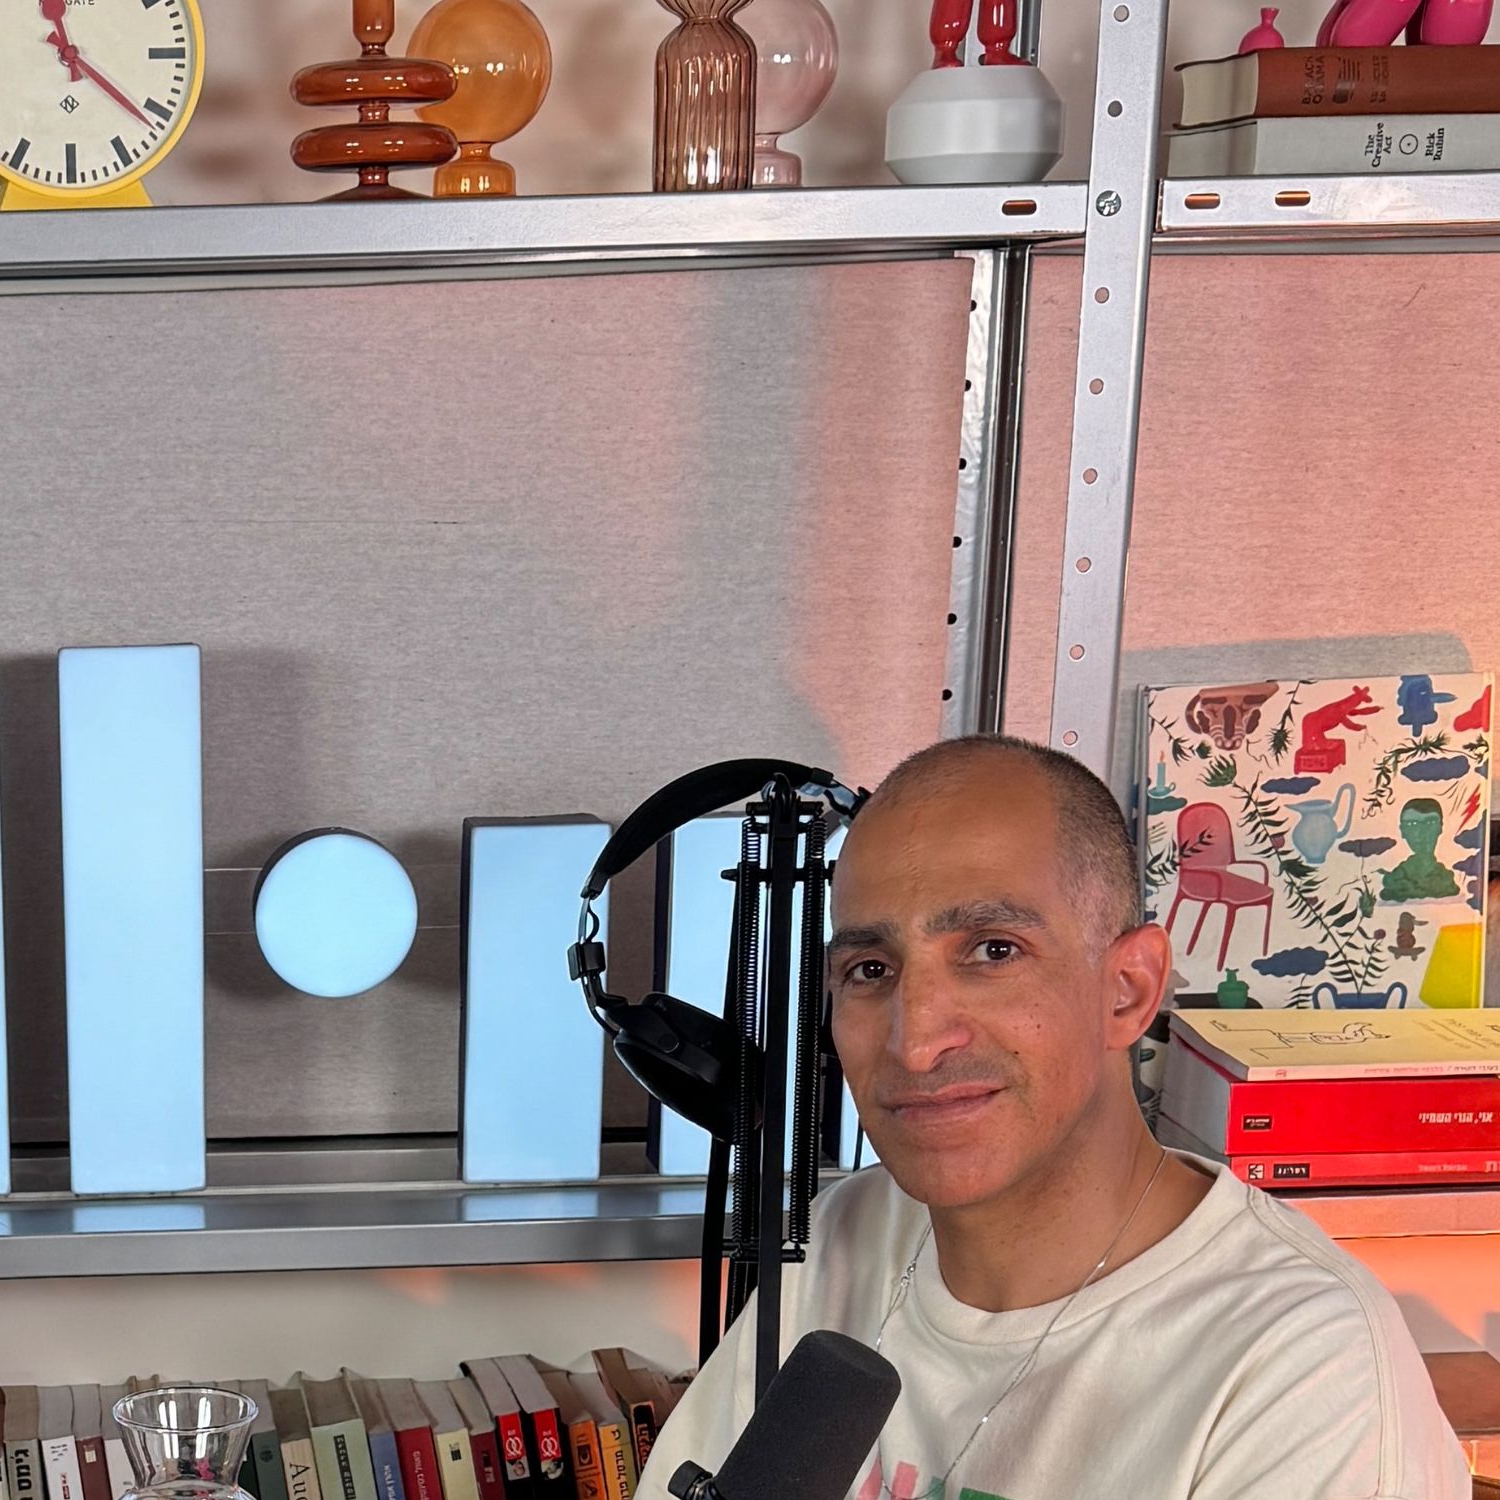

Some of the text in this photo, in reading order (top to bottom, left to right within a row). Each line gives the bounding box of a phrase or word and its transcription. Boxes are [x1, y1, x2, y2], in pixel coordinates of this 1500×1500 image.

[1364, 134, 1374, 156] The
[1372, 122, 1383, 168] Creative
[1383, 136, 1392, 154] Act
[1425, 132, 1435, 157] Rick
[1434, 127, 1444, 161] Rubin
